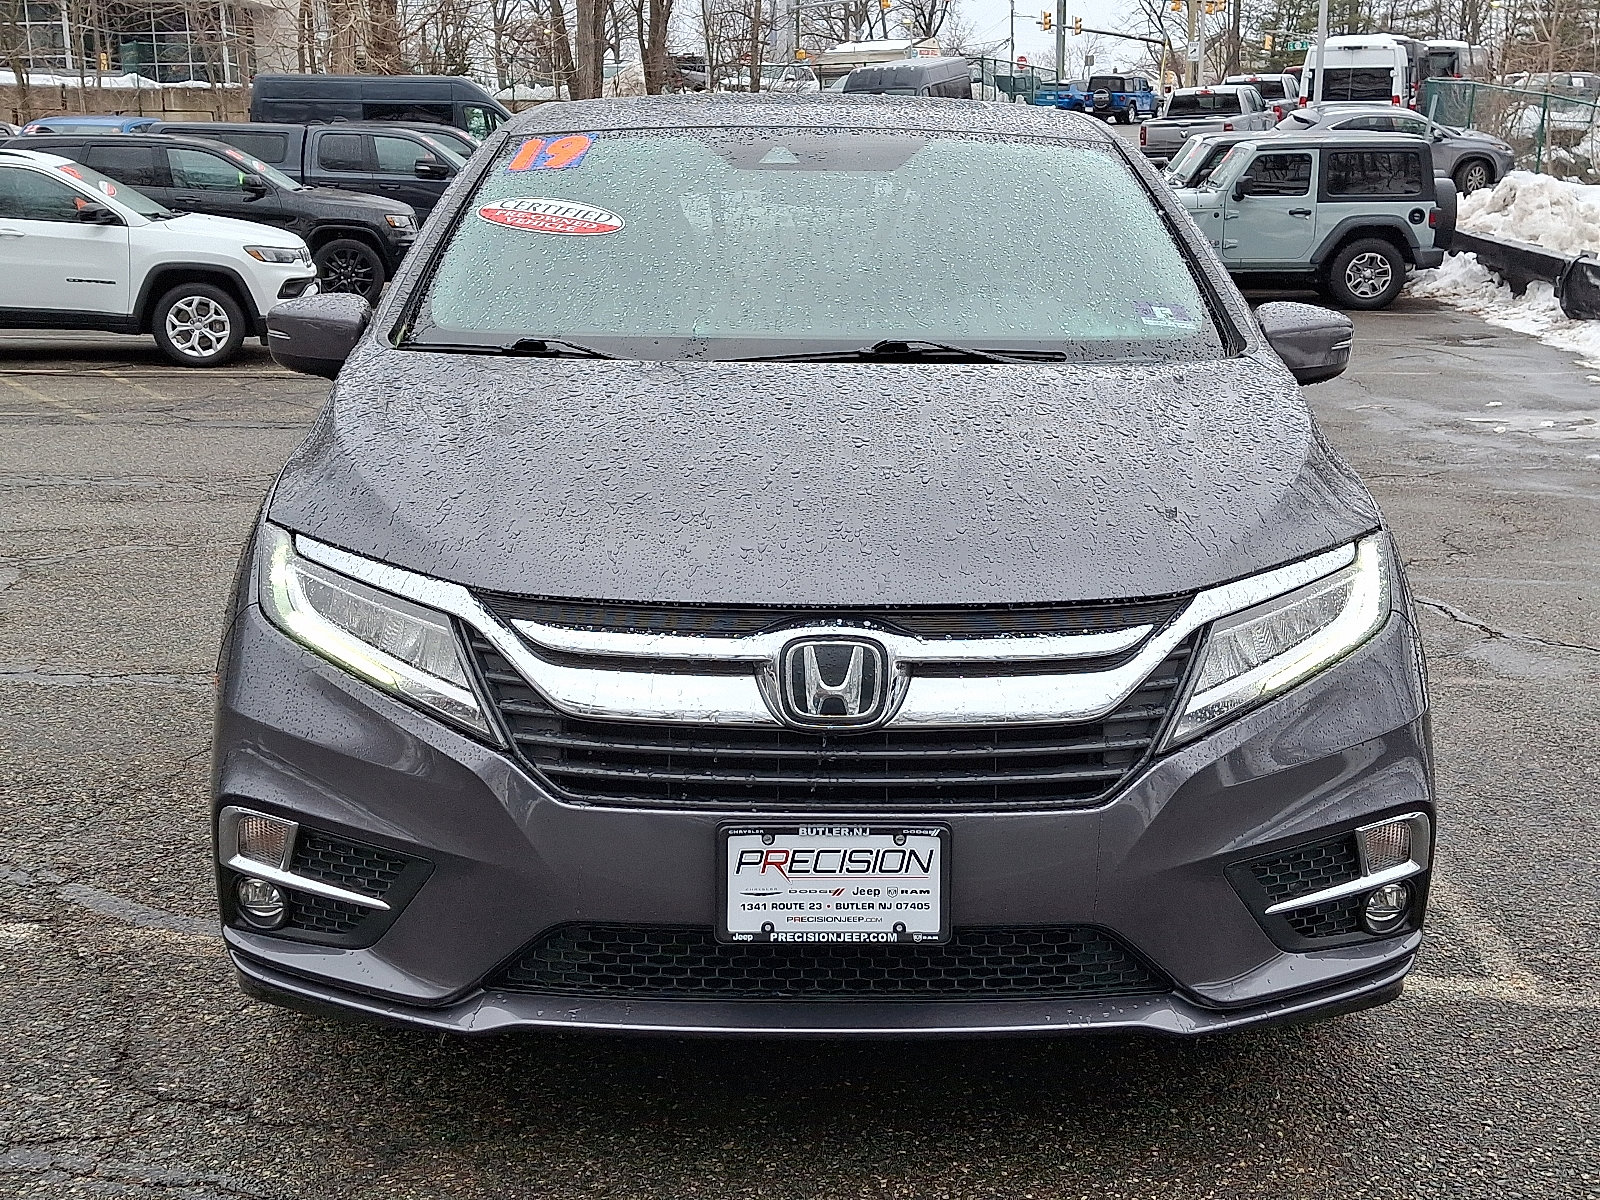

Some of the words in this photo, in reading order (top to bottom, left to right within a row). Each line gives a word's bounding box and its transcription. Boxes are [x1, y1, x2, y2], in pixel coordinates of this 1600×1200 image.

[508, 135, 592, 170] 19
[499, 200, 613, 223] CERTIFIED
[505, 216, 576, 232] VEHICLE
[735, 849, 934, 876] PRECISION
[852, 886, 881, 897] Jeep
[740, 902, 767, 911] 1341
[771, 902, 805, 910] ROUTE
[808, 902, 822, 910] 23
[835, 902, 875, 910] BUTLER
[878, 902, 893, 910] NJ
[895, 902, 931, 910] 07405
[732, 933, 754, 942] Jeep
[770, 932, 898, 942] PRECISIONJEEP.COM
